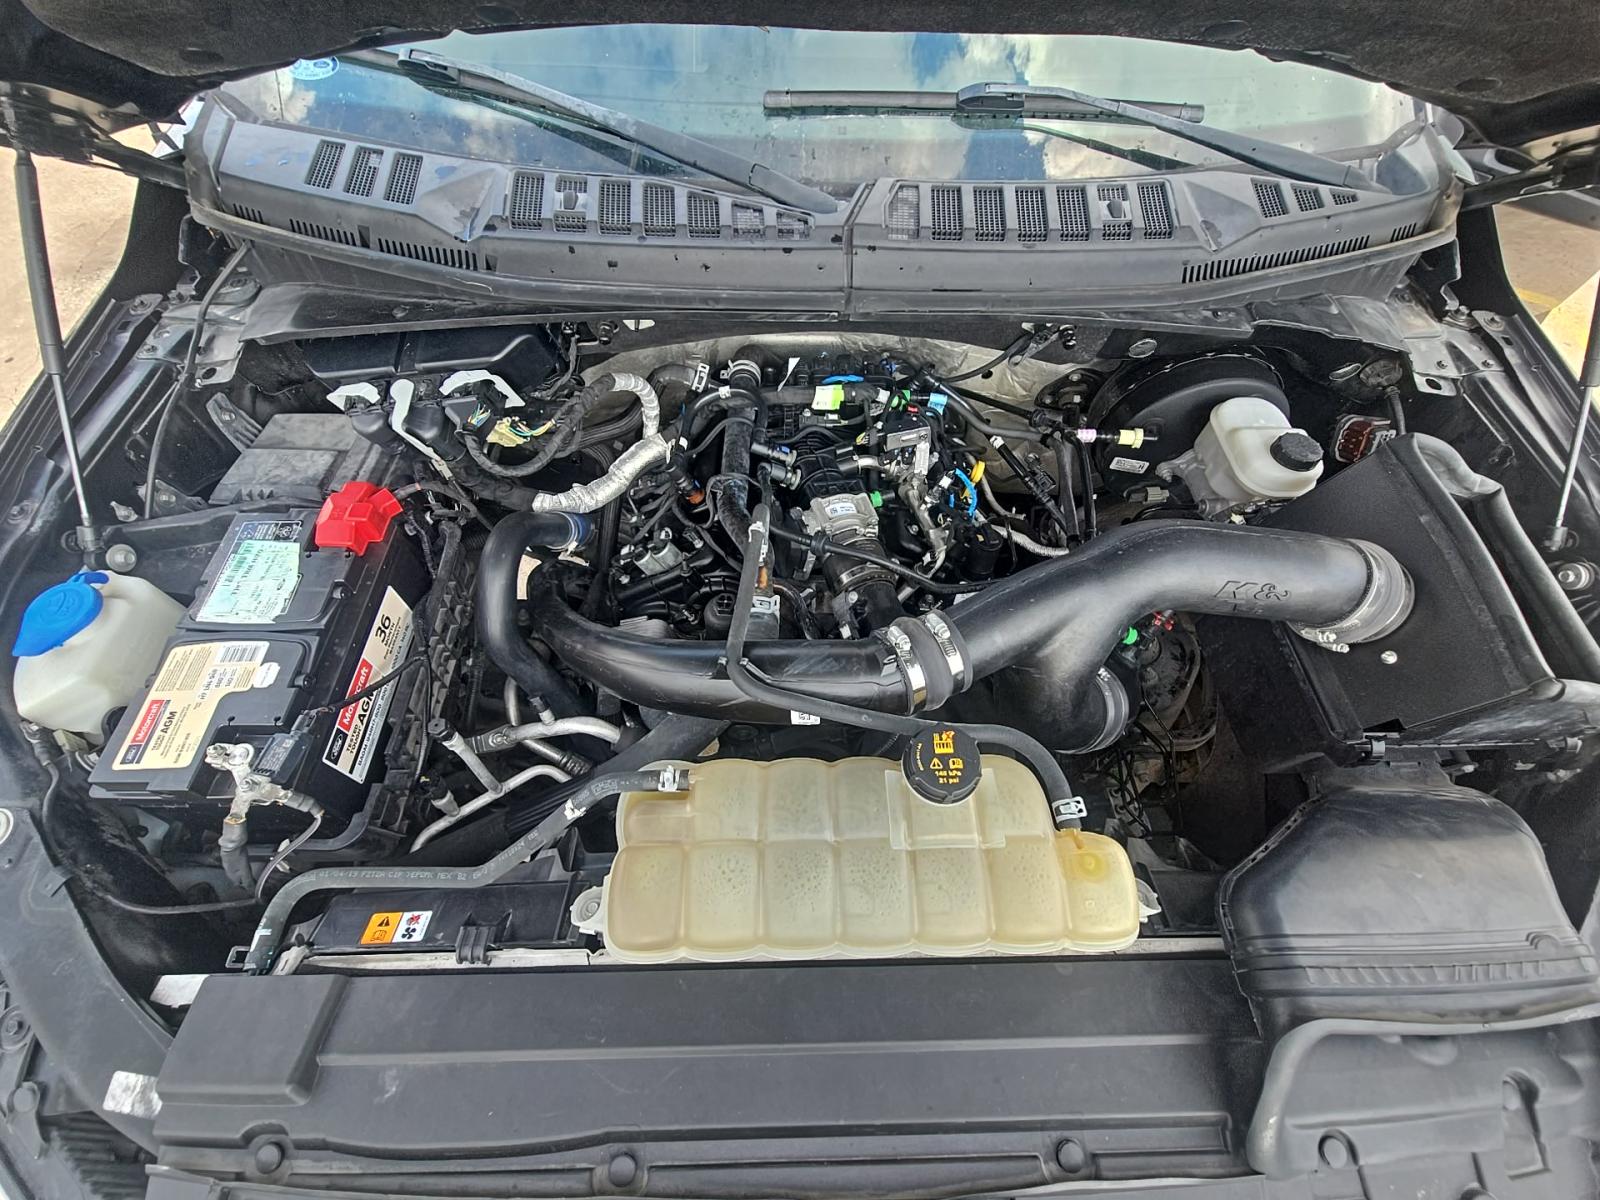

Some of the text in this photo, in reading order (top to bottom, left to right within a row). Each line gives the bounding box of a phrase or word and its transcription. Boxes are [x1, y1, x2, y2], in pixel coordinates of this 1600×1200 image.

[375, 614, 391, 644] 36
[384, 623, 396, 648] MONTH
[342, 667, 369, 725] Mocraft
[134, 702, 161, 742] Motorcraft
[160, 711, 178, 734] AGM
[346, 724, 359, 752] TESTED
